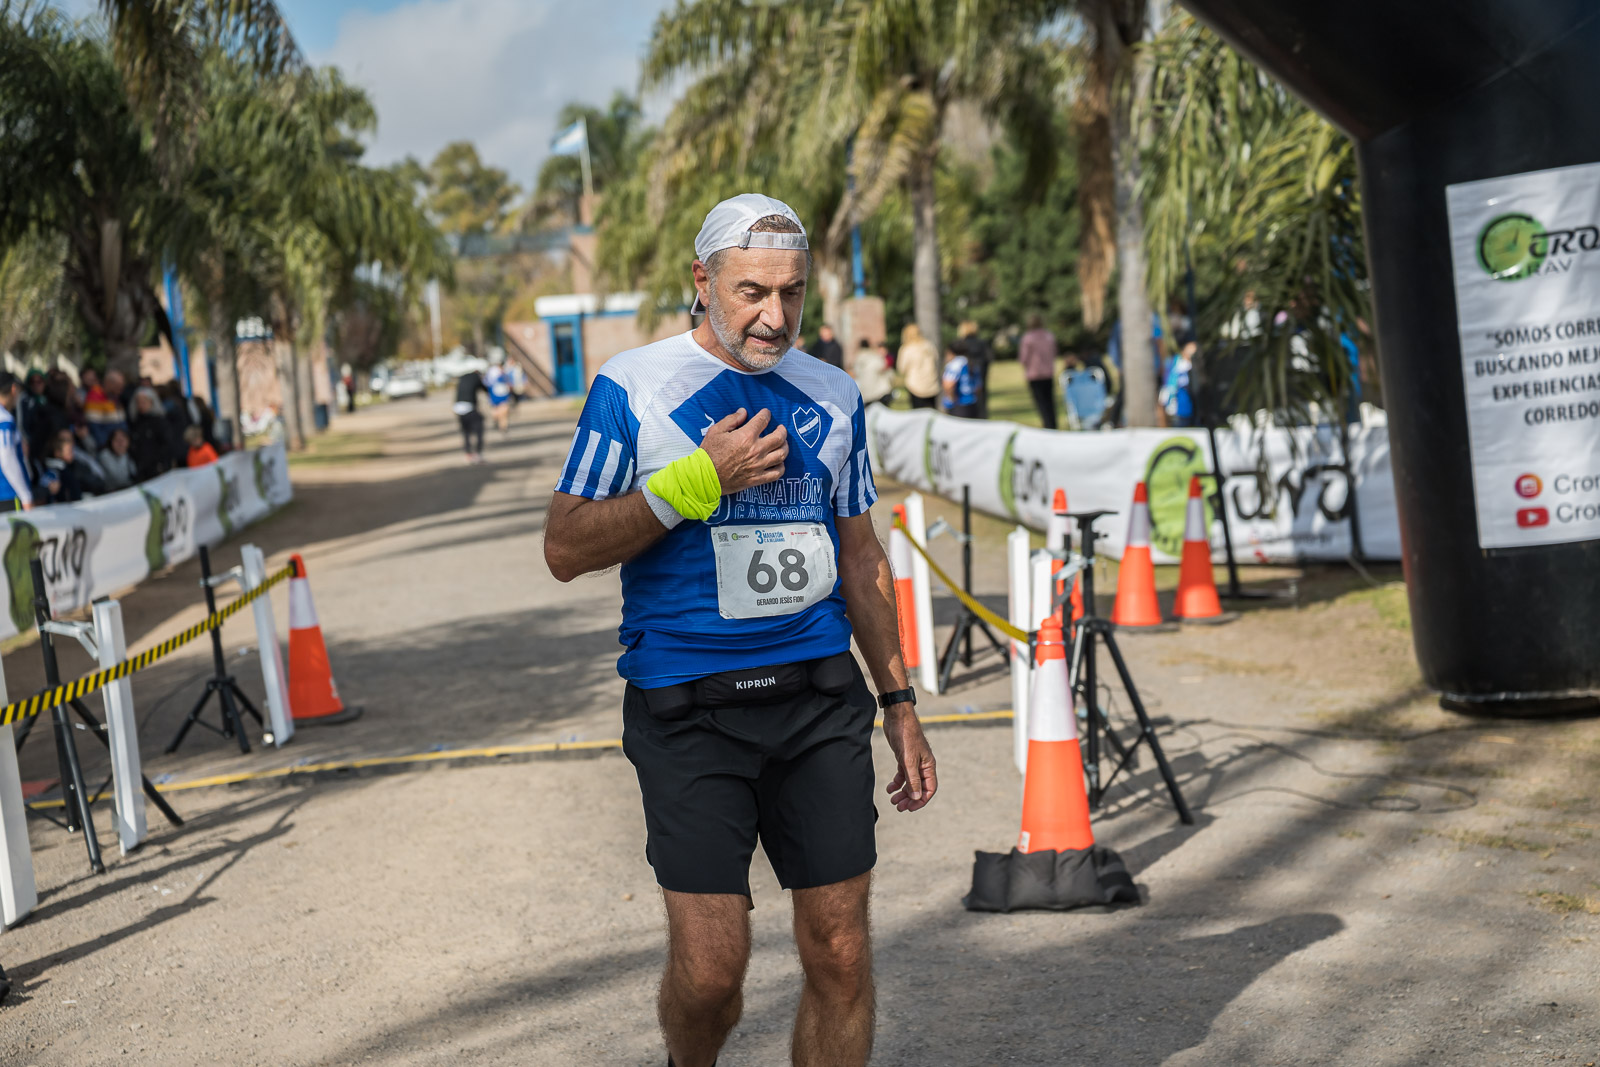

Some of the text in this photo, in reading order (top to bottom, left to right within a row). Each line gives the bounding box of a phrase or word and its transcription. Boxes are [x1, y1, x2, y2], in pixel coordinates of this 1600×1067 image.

[1474, 344, 1600, 378] BUSCANDO MEJ
[1524, 401, 1600, 426] CORREDO
[1556, 501, 1600, 525] Cro
[747, 548, 809, 594] 68
[756, 597, 779, 606] GERARDO
[735, 676, 776, 690] KIPRUN
